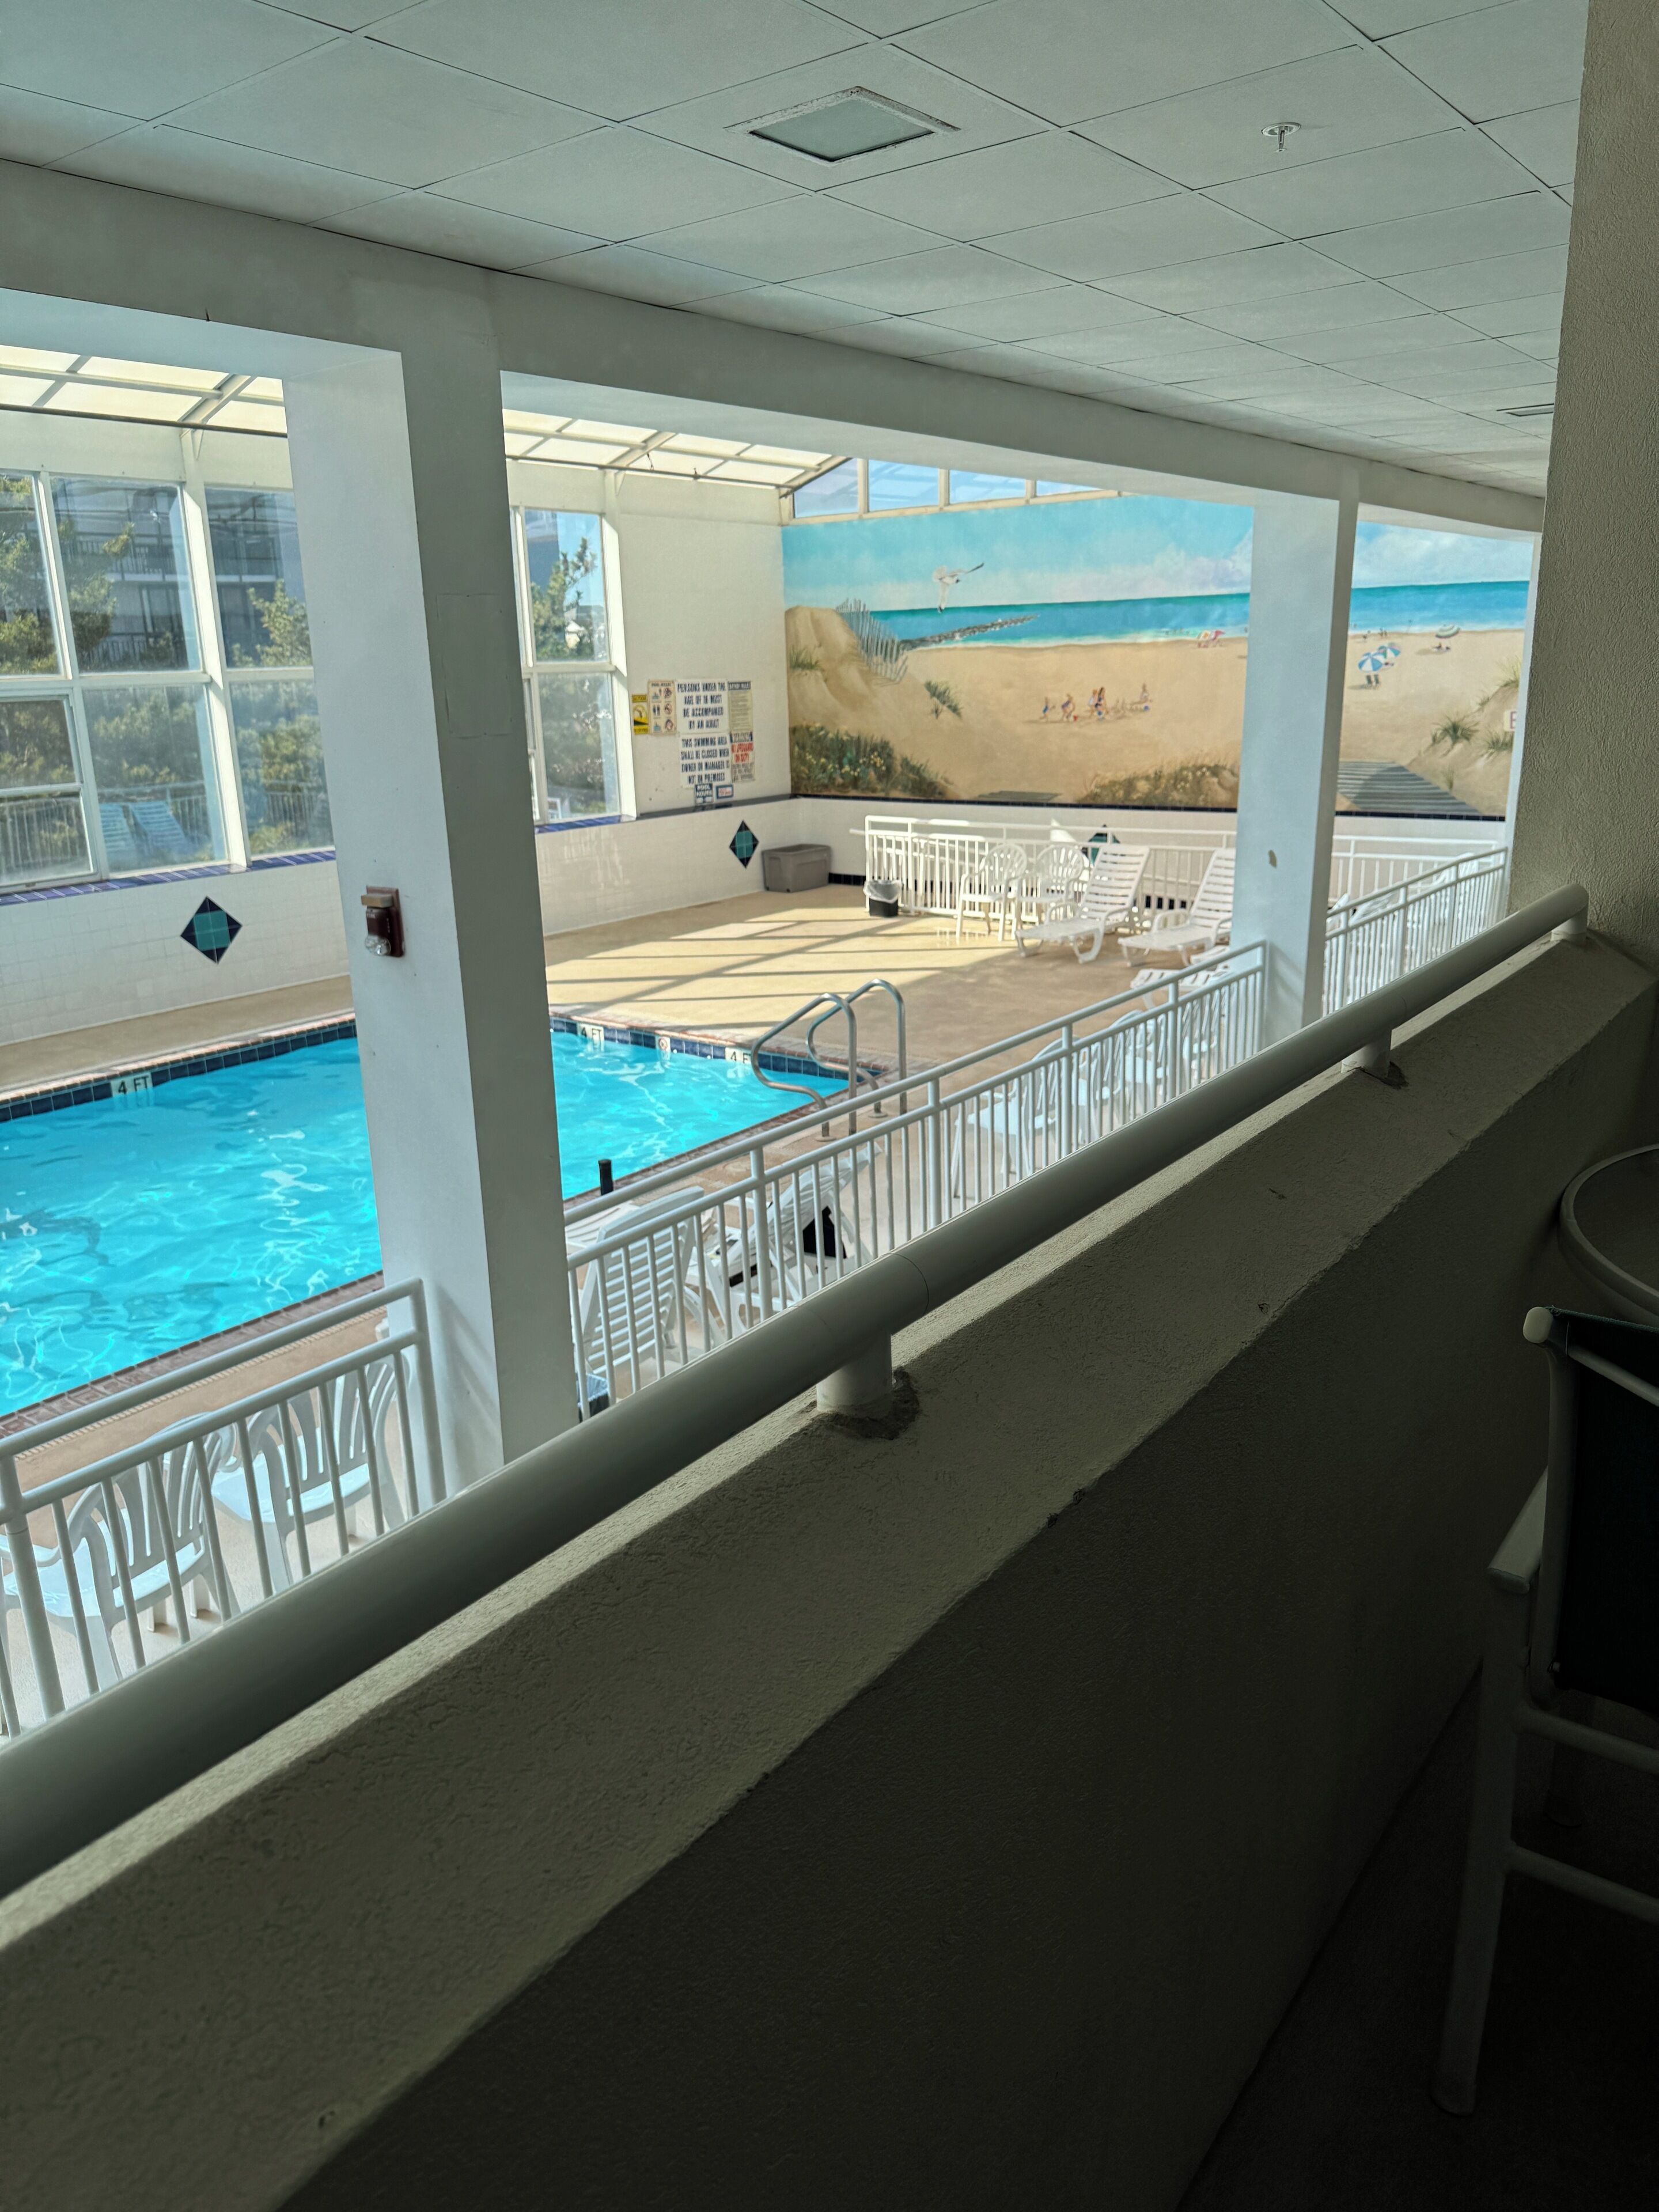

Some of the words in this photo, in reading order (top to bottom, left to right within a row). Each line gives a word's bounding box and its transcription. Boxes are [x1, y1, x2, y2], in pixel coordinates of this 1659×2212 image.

[677, 684, 700, 692] PERSONS
[702, 683, 716, 691] UNDER
[718, 682, 726, 691] THE
[684, 695, 693, 704] AGE
[696, 695, 701, 704] OF
[710, 695, 722, 704] MUST
[683, 709, 689, 717] BE
[692, 707, 724, 717] ACCOMPANIED
[689, 720, 695, 729] BY
[698, 719, 704, 729] AN
[706, 718, 719, 728] ADULT
[682, 738, 692, 748] THIS
[694, 737, 716, 747] SWIMMING
[718, 736, 727, 745] AREA
[681, 751, 694, 760] SHALL
[696, 751, 700, 759] BE
[702, 749, 717, 759] CLOSED
[719, 748, 729, 757] WHEN
[682, 763, 696, 772] OWNER
[698, 762, 703, 771] OR
[705, 761, 724, 770] MANAGER
[698, 774, 703, 783] ON
[704, 772, 725, 782] PREMISES
[118, 1081, 127, 1094] 4
[134, 1076, 149, 1091] FT
